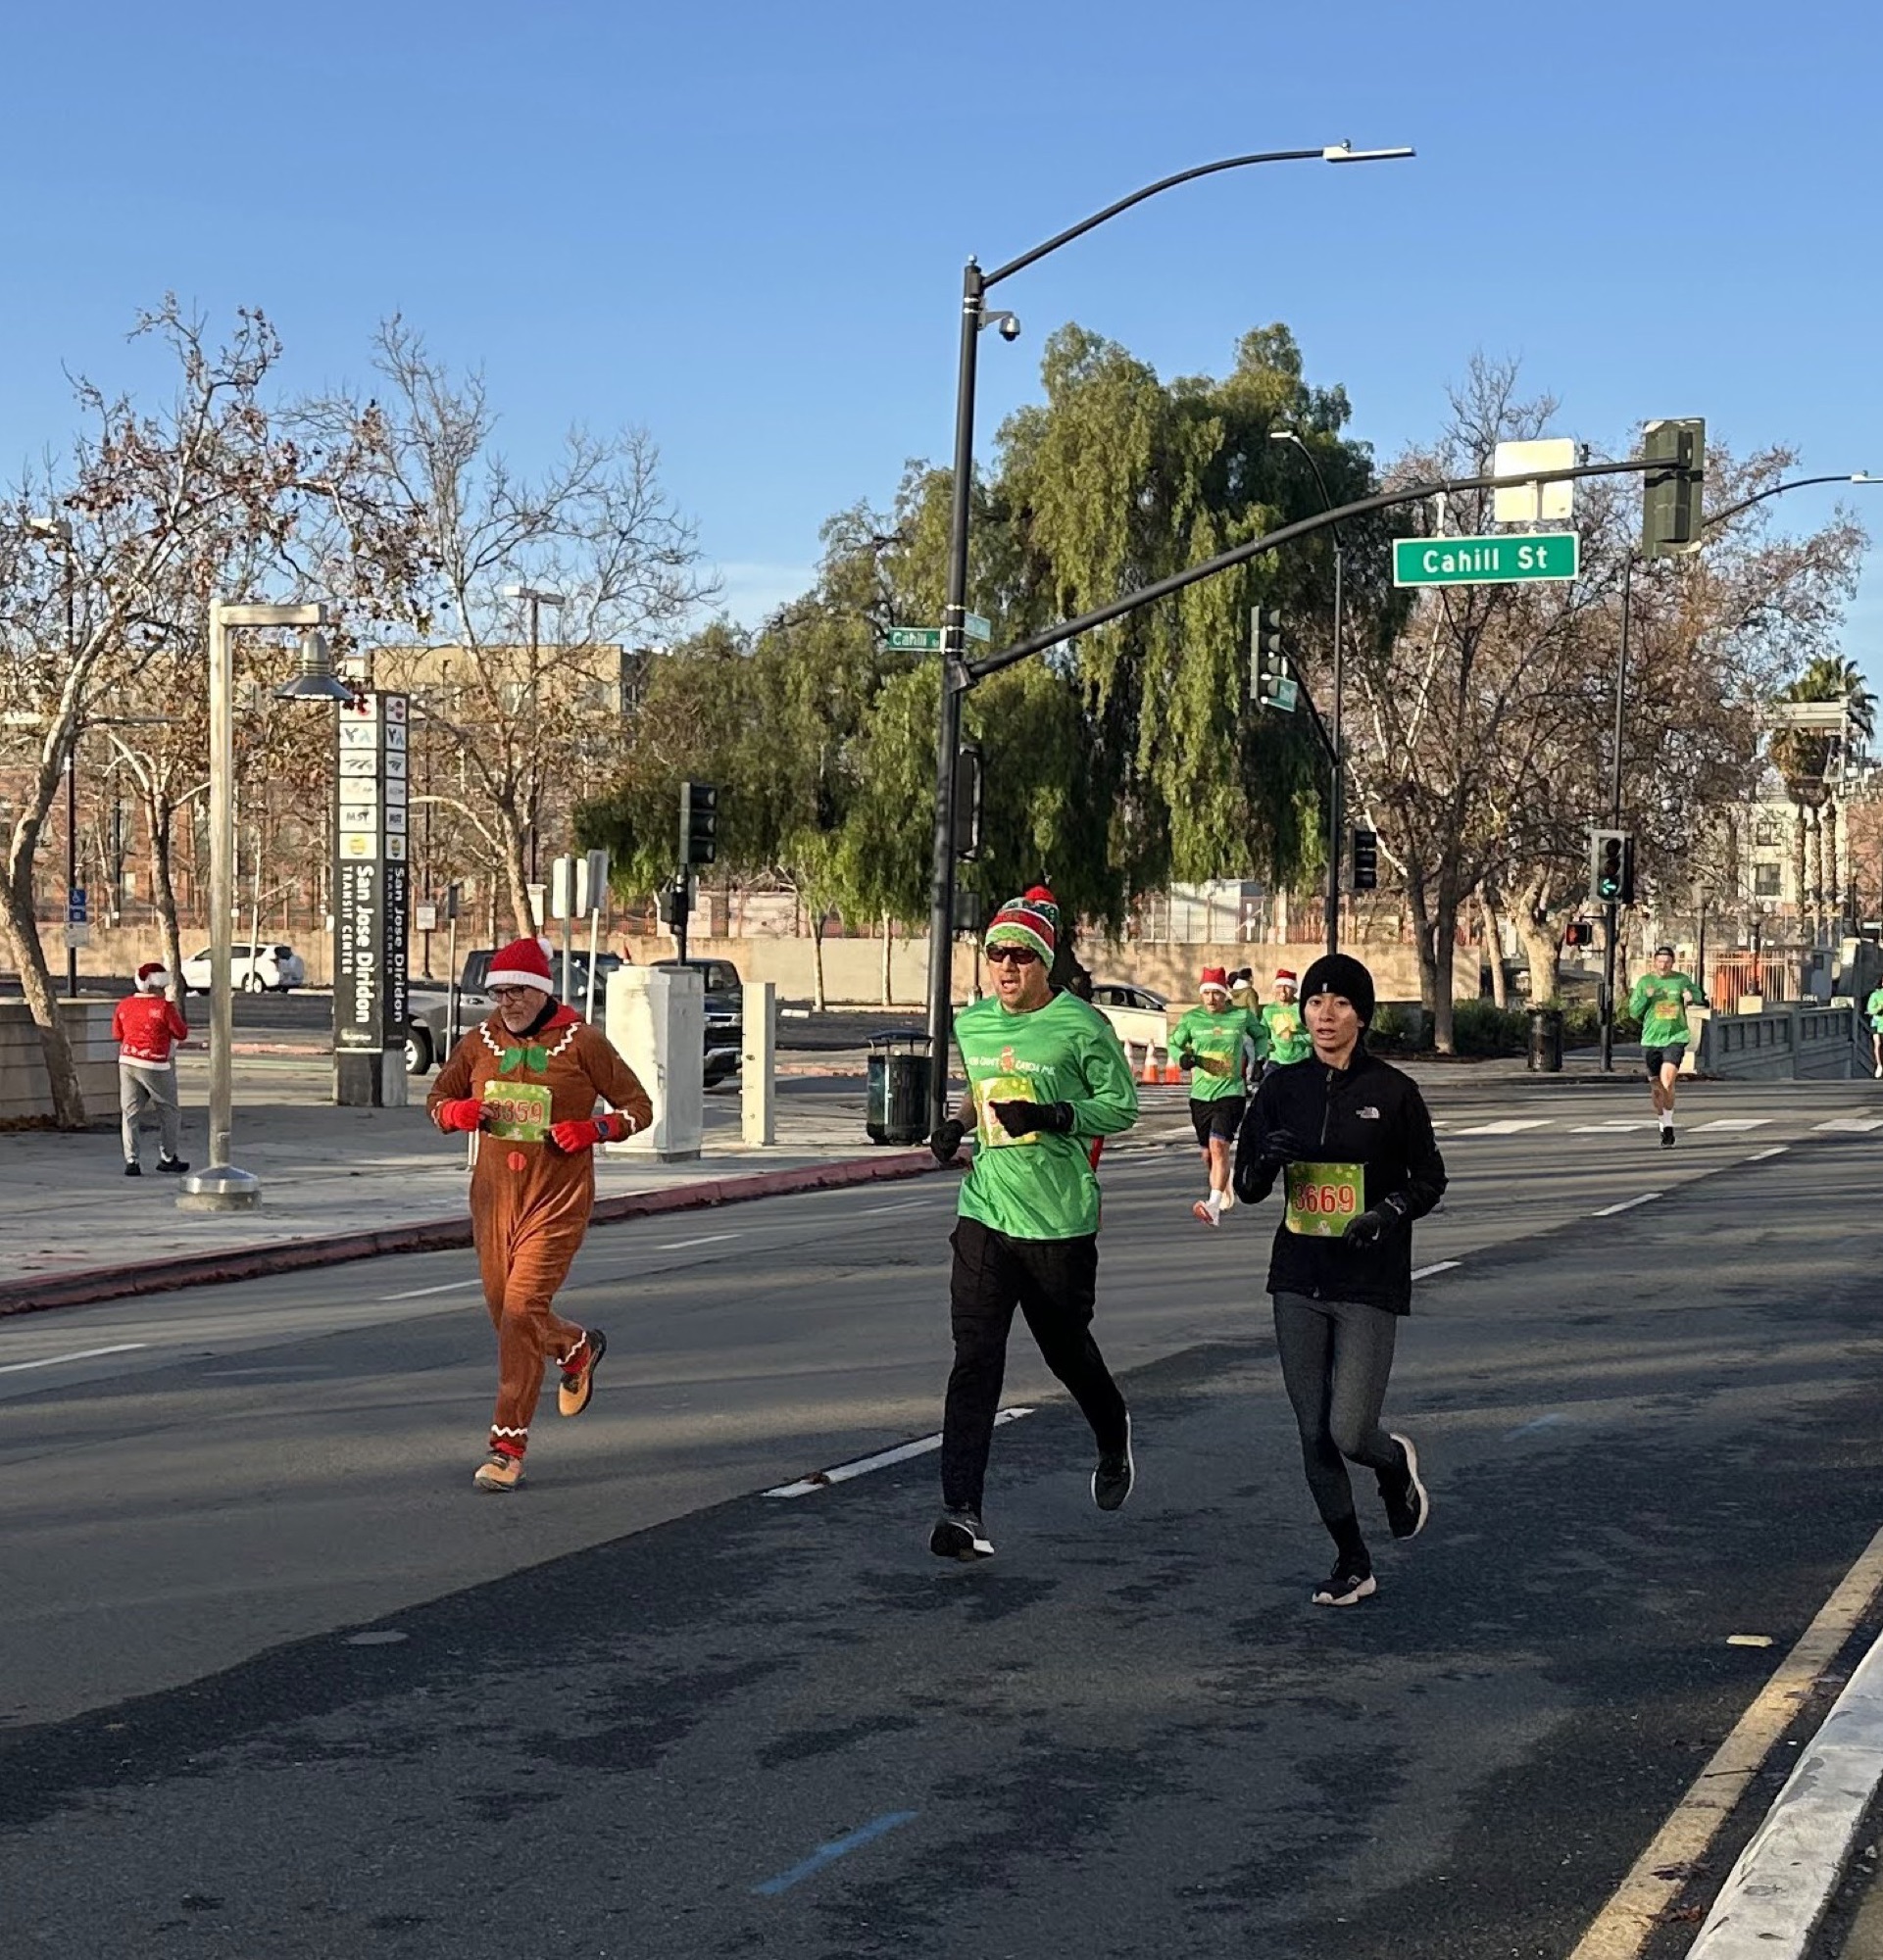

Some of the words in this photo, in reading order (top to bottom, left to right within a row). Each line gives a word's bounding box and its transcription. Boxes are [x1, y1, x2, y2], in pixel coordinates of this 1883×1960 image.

[1422, 547, 1500, 574] Cahill
[1517, 545, 1548, 570] St
[342, 865, 353, 919] TRANSIT
[356, 865, 375, 901] San
[394, 867, 405, 902] San
[356, 905, 375, 948] Jose
[394, 906, 406, 948] Jose
[342, 924, 353, 975] CENTER
[356, 952, 375, 1023] Diridon
[394, 954, 406, 1023] Diridon
[1293, 1182, 1357, 1215] 3669
